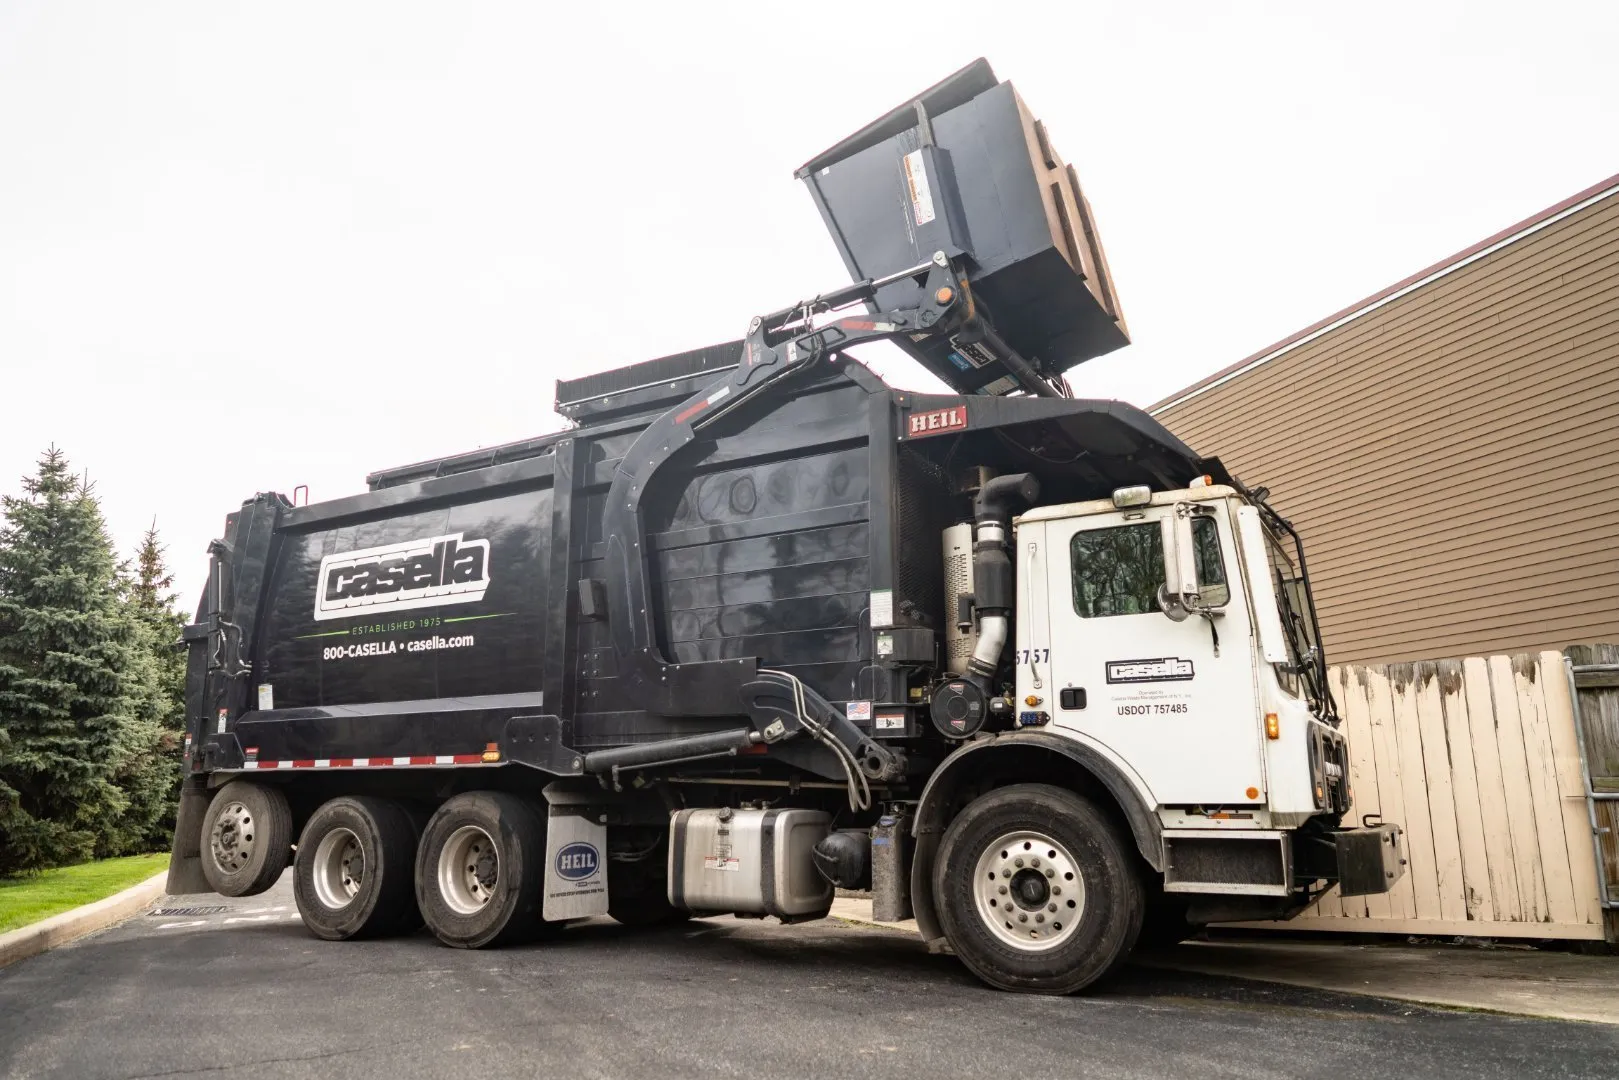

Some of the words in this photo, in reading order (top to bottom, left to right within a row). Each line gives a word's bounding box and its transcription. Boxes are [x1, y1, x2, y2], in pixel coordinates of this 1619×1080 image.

[911, 410, 963, 433] HEIL
[322, 537, 486, 604] casella
[352, 621, 416, 636] ESTABLISHED
[419, 618, 441, 628] 1975
[323, 640, 397, 660] 800-CASELLA
[407, 635, 474, 652] casella.com
[1108, 658, 1194, 681] casella
[1117, 705, 1151, 716] USDOT
[1154, 703, 1188, 714] 757485
[561, 853, 595, 870] HEIL
